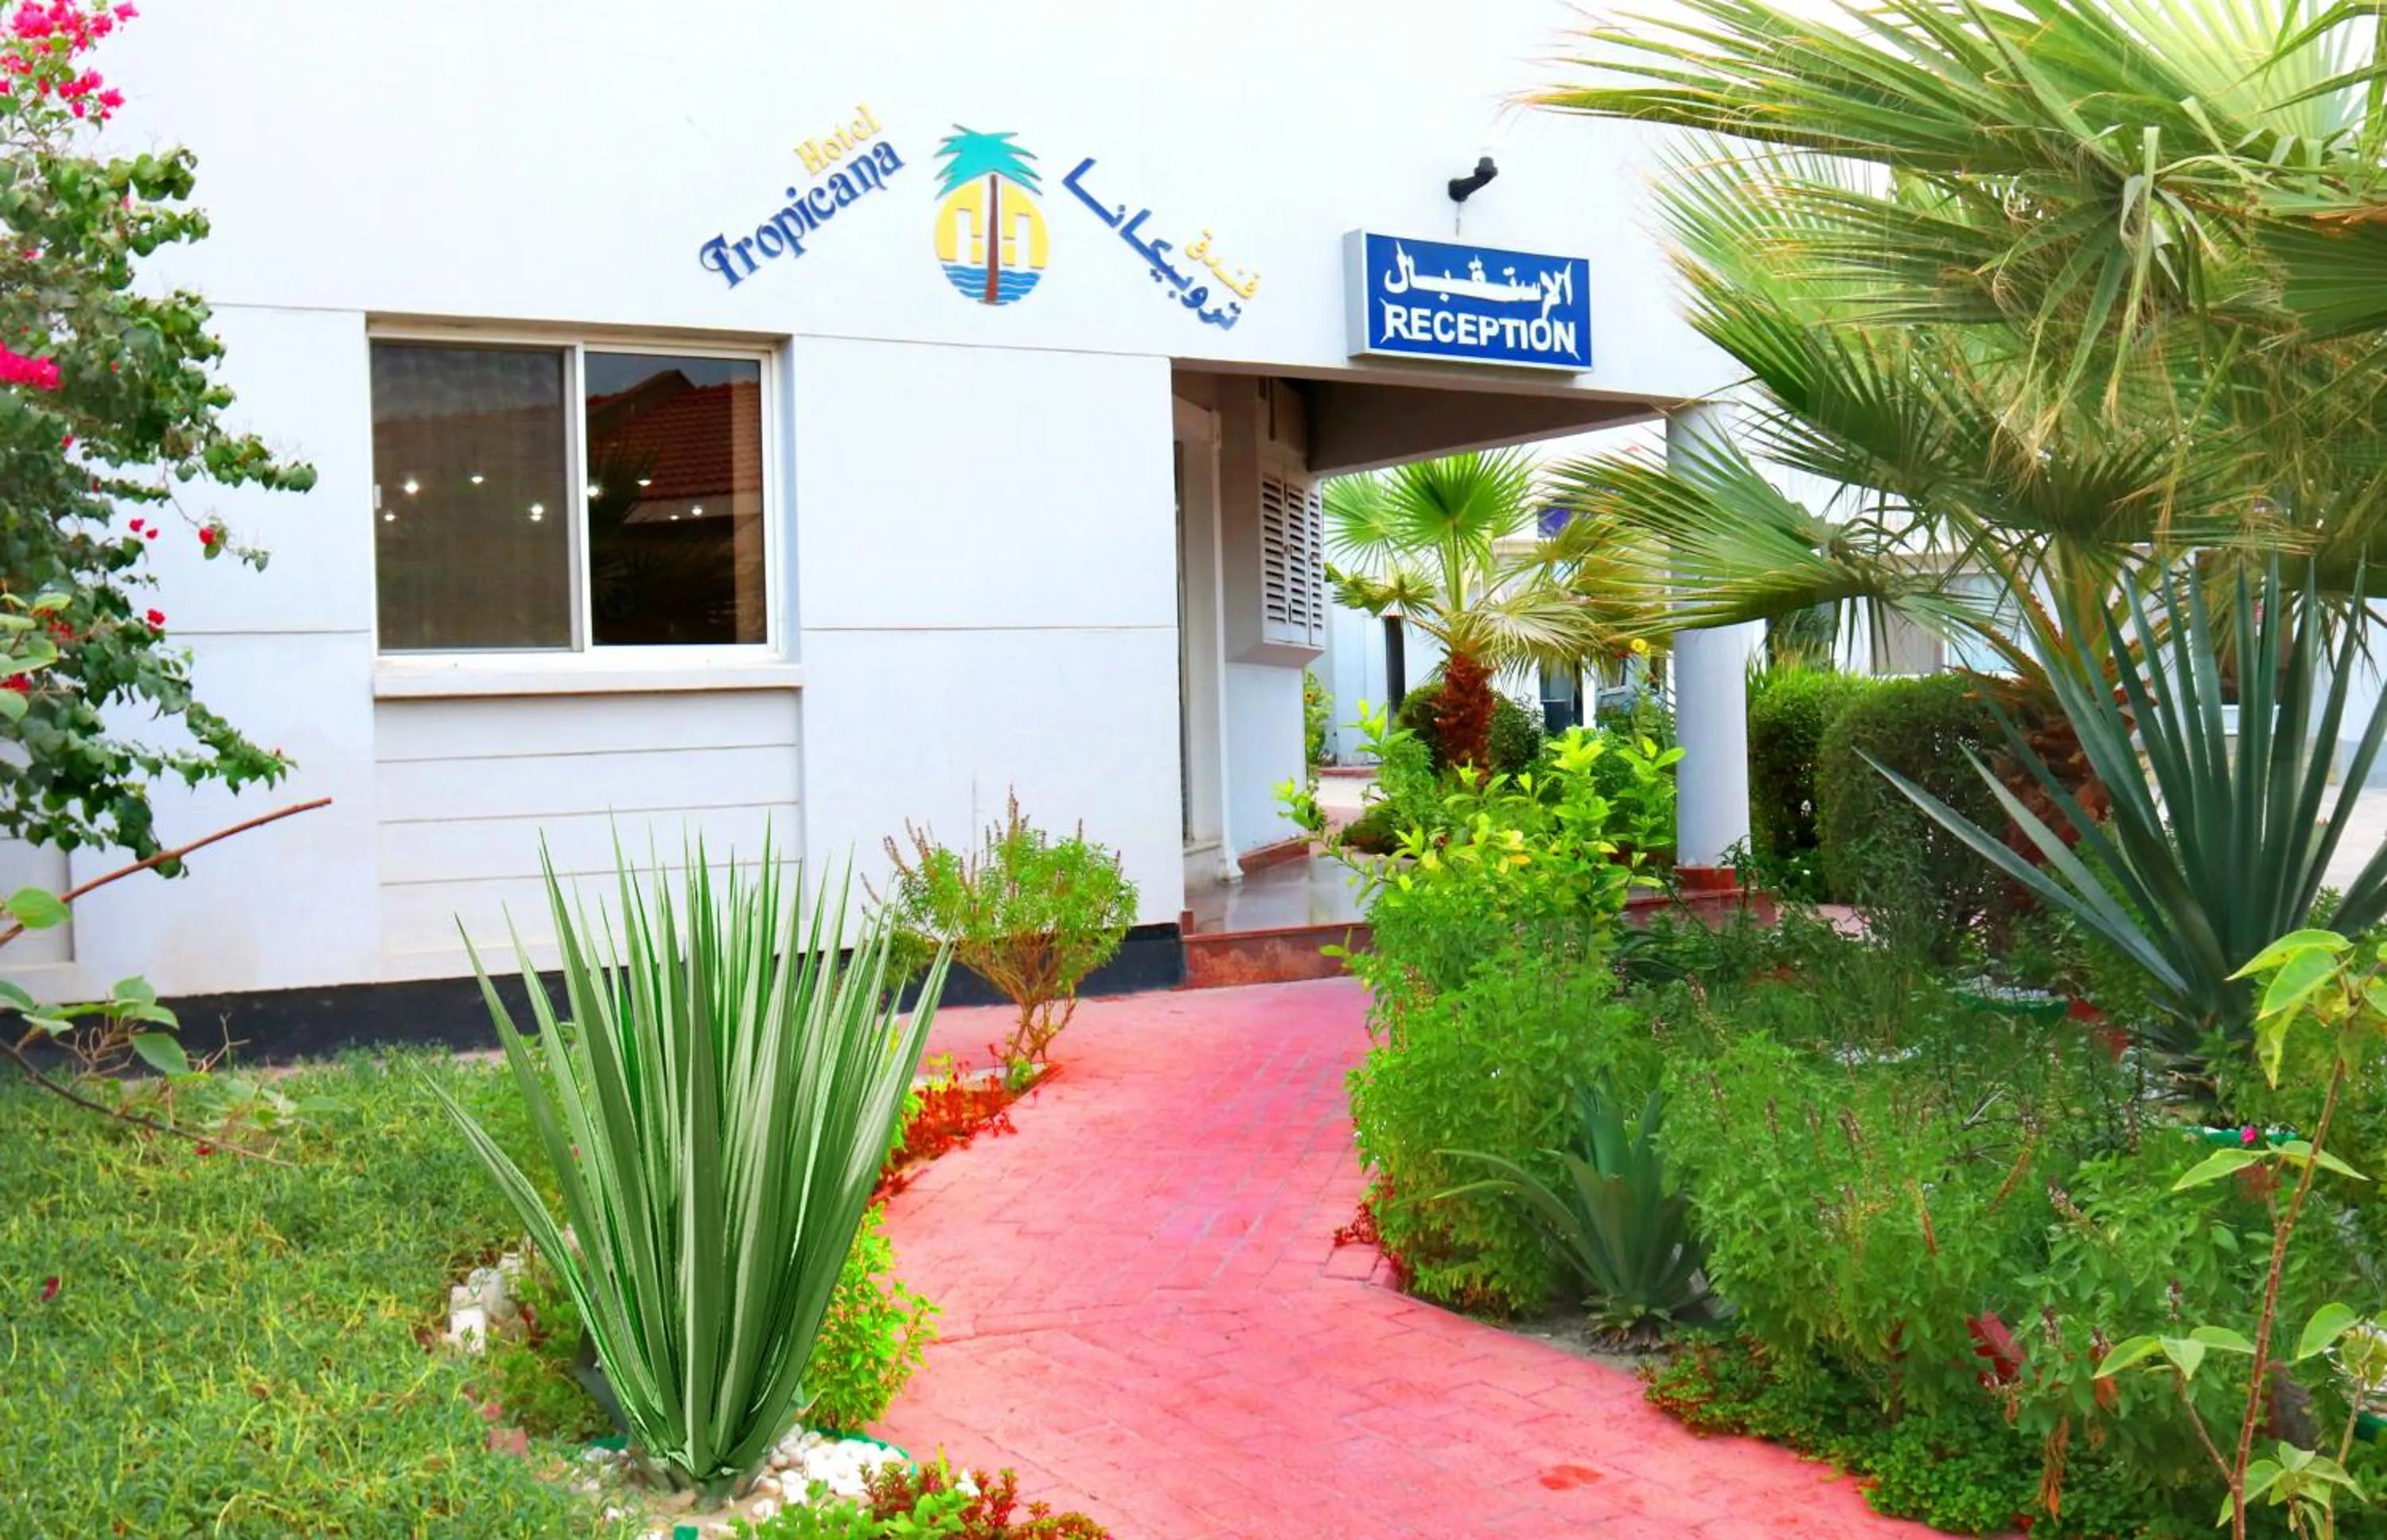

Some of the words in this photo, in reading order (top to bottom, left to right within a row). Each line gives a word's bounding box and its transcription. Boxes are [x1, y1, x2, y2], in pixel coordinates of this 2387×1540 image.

[794, 103, 882, 177] Hotel
[699, 141, 906, 290] Tropicana
[1061, 157, 1242, 330] تروبيكانا
[1185, 228, 1260, 300] فندق
[1380, 298, 1580, 360] RECEPTION
